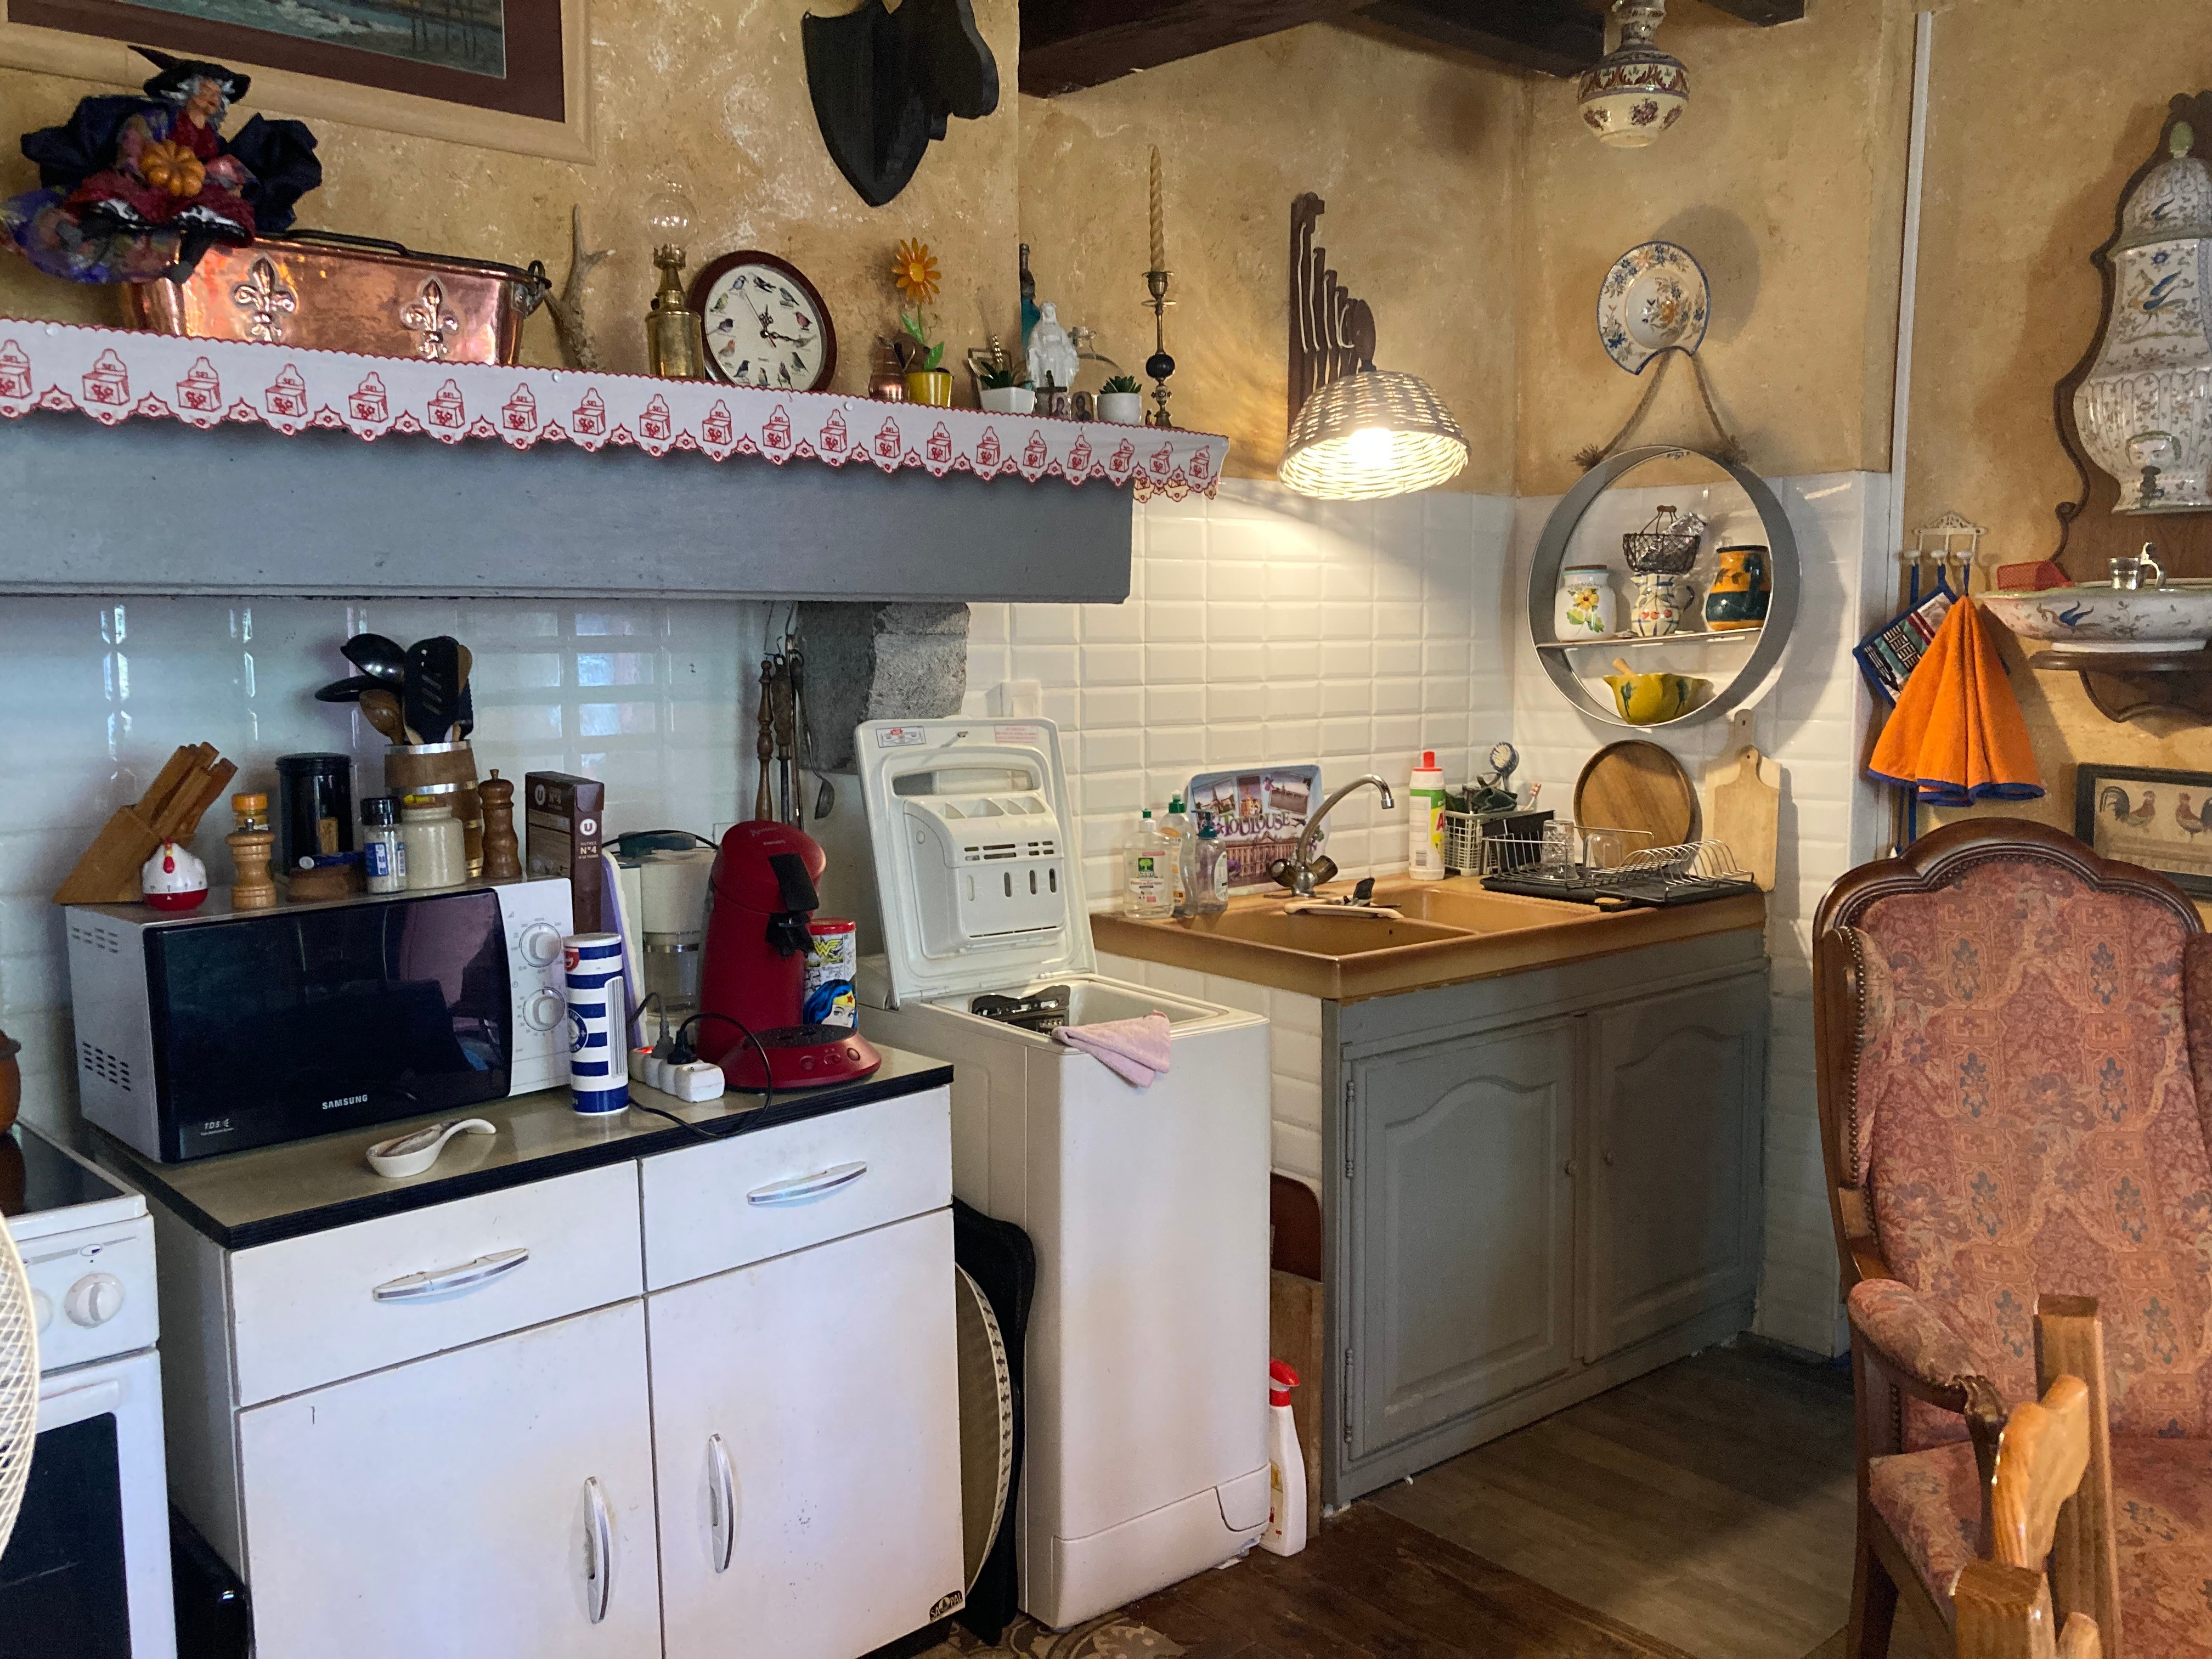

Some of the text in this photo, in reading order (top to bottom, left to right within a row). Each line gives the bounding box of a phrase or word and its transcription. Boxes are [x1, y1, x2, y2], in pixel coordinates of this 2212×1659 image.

[1219, 811, 1290, 836] TOULOUSE
[580, 845, 596, 854] N°4
[322, 1094, 368, 1110] SAMSUNG
